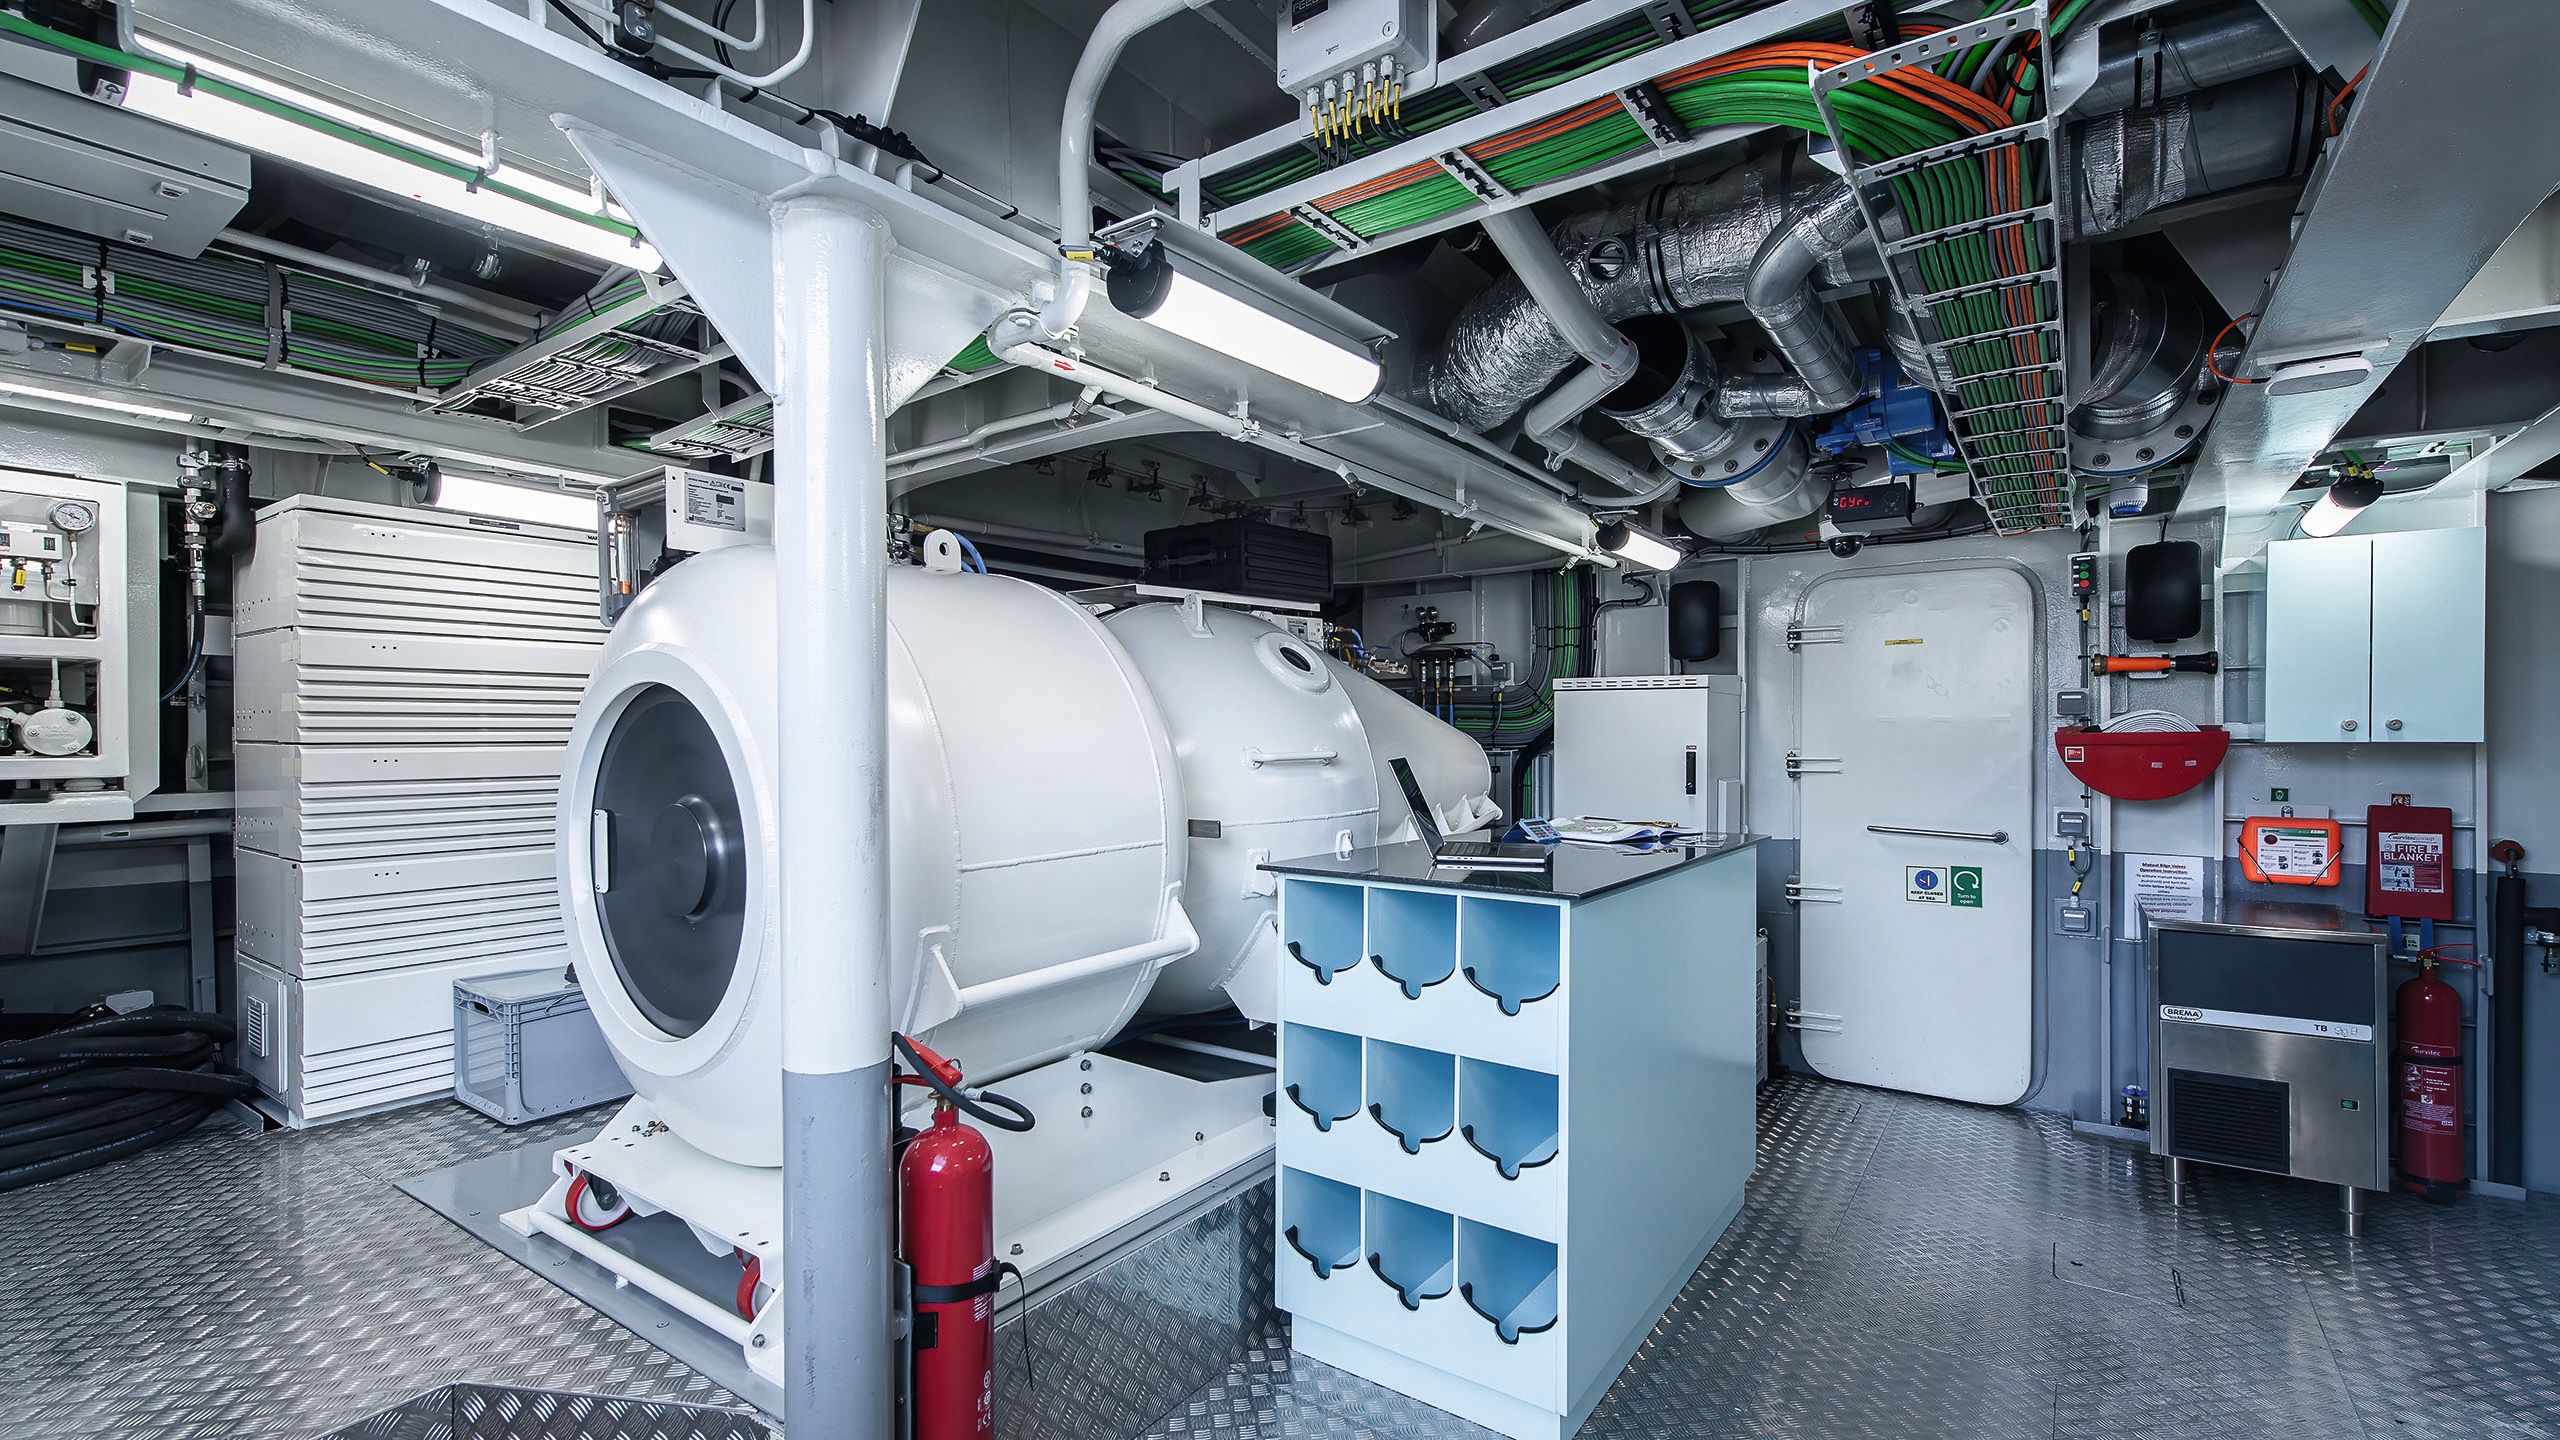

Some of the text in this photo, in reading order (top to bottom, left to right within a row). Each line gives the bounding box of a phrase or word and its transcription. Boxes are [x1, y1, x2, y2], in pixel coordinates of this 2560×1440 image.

[2397, 844, 2425, 854] FIRE
[2383, 852, 2440, 862] BLANKET
[2167, 1008, 2200, 1018] BREMA
[2314, 1023, 2328, 1032] TB
